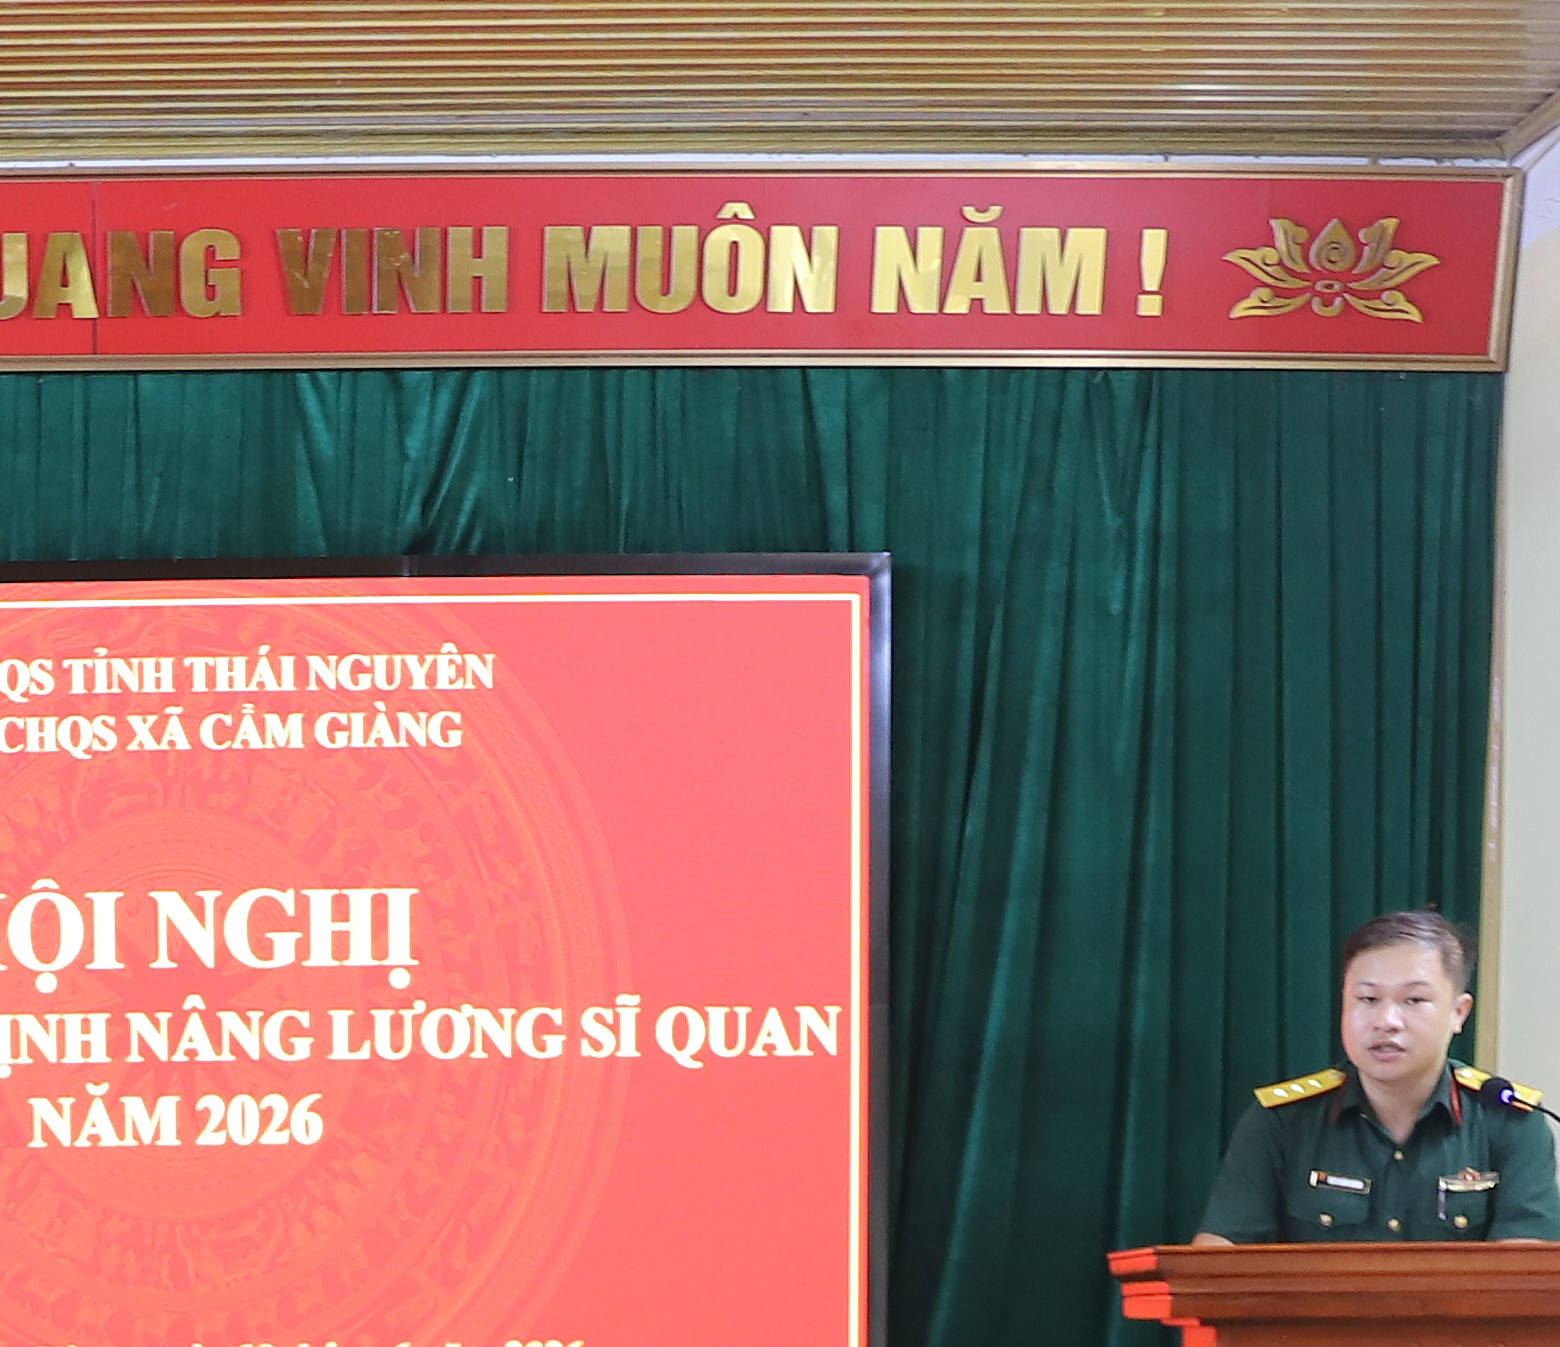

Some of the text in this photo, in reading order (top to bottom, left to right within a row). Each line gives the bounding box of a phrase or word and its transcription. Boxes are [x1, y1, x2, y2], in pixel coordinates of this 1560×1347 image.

[276, 225, 509, 316] VINH
[541, 201, 840, 315] MUÔN
[870, 204, 1108, 317] NĂM
[1135, 227, 1170, 317] !
[63, 646, 177, 695] TỈNH
[183, 645, 298, 693] THÁI
[306, 642, 496, 692] NGUYÊN
[126, 705, 192, 752] XÃ
[313, 700, 464, 749] GIÀNG
[147, 887, 420, 990] NGHỊ
[125, 994, 315, 1063] NÂNG
[326, 999, 567, 1061] LƯƠNG
[580, 993, 642, 1059] SĨ
[655, 1005, 843, 1070] QUAN
[28, 1082, 324, 1148] NĂM 2026
